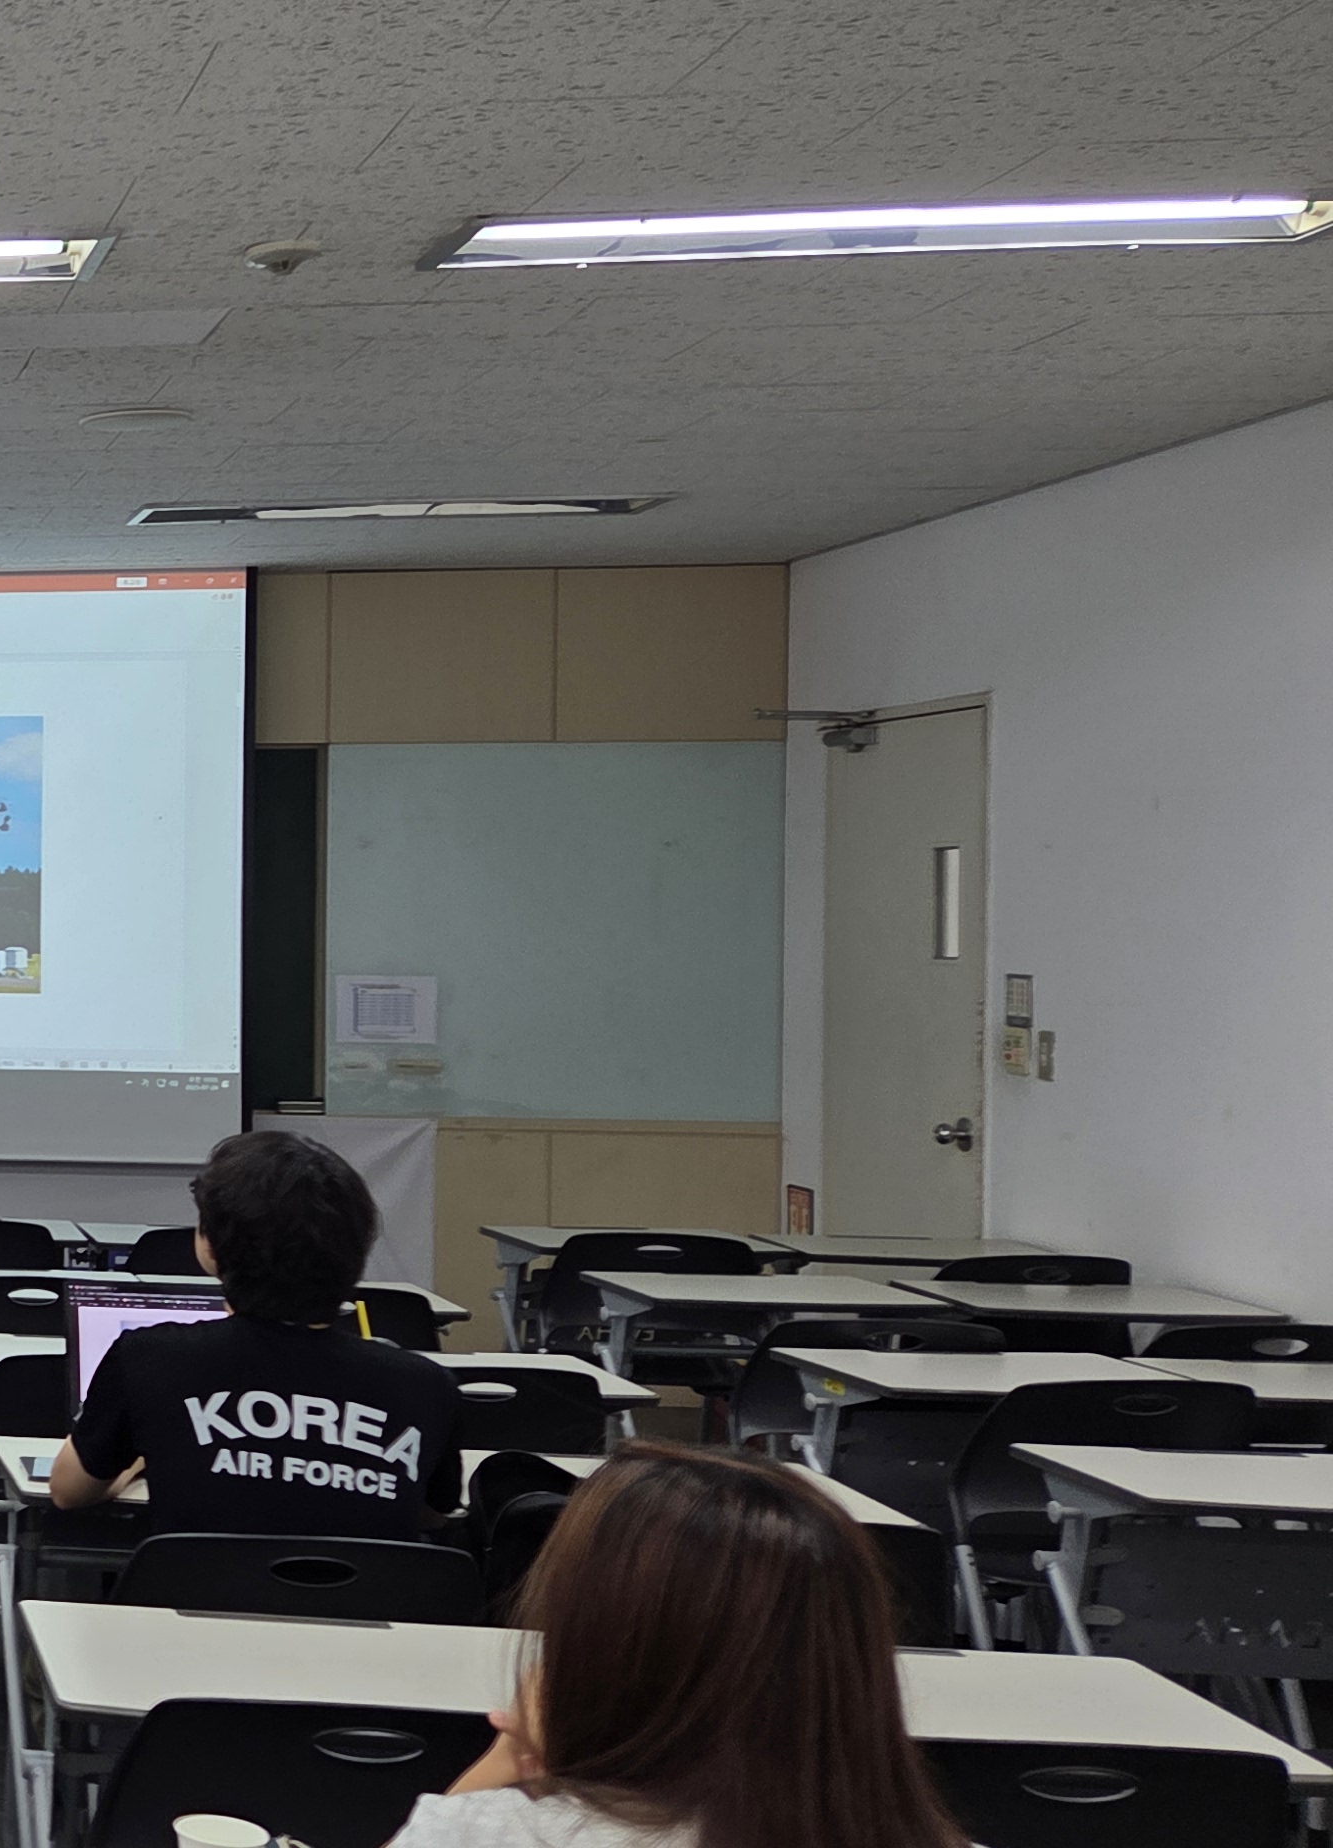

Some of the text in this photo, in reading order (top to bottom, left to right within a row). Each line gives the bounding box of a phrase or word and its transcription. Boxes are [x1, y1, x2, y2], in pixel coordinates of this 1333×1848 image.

[184, 1390, 422, 1482] KOREA
[211, 1448, 398, 1500] AIR FORCE
